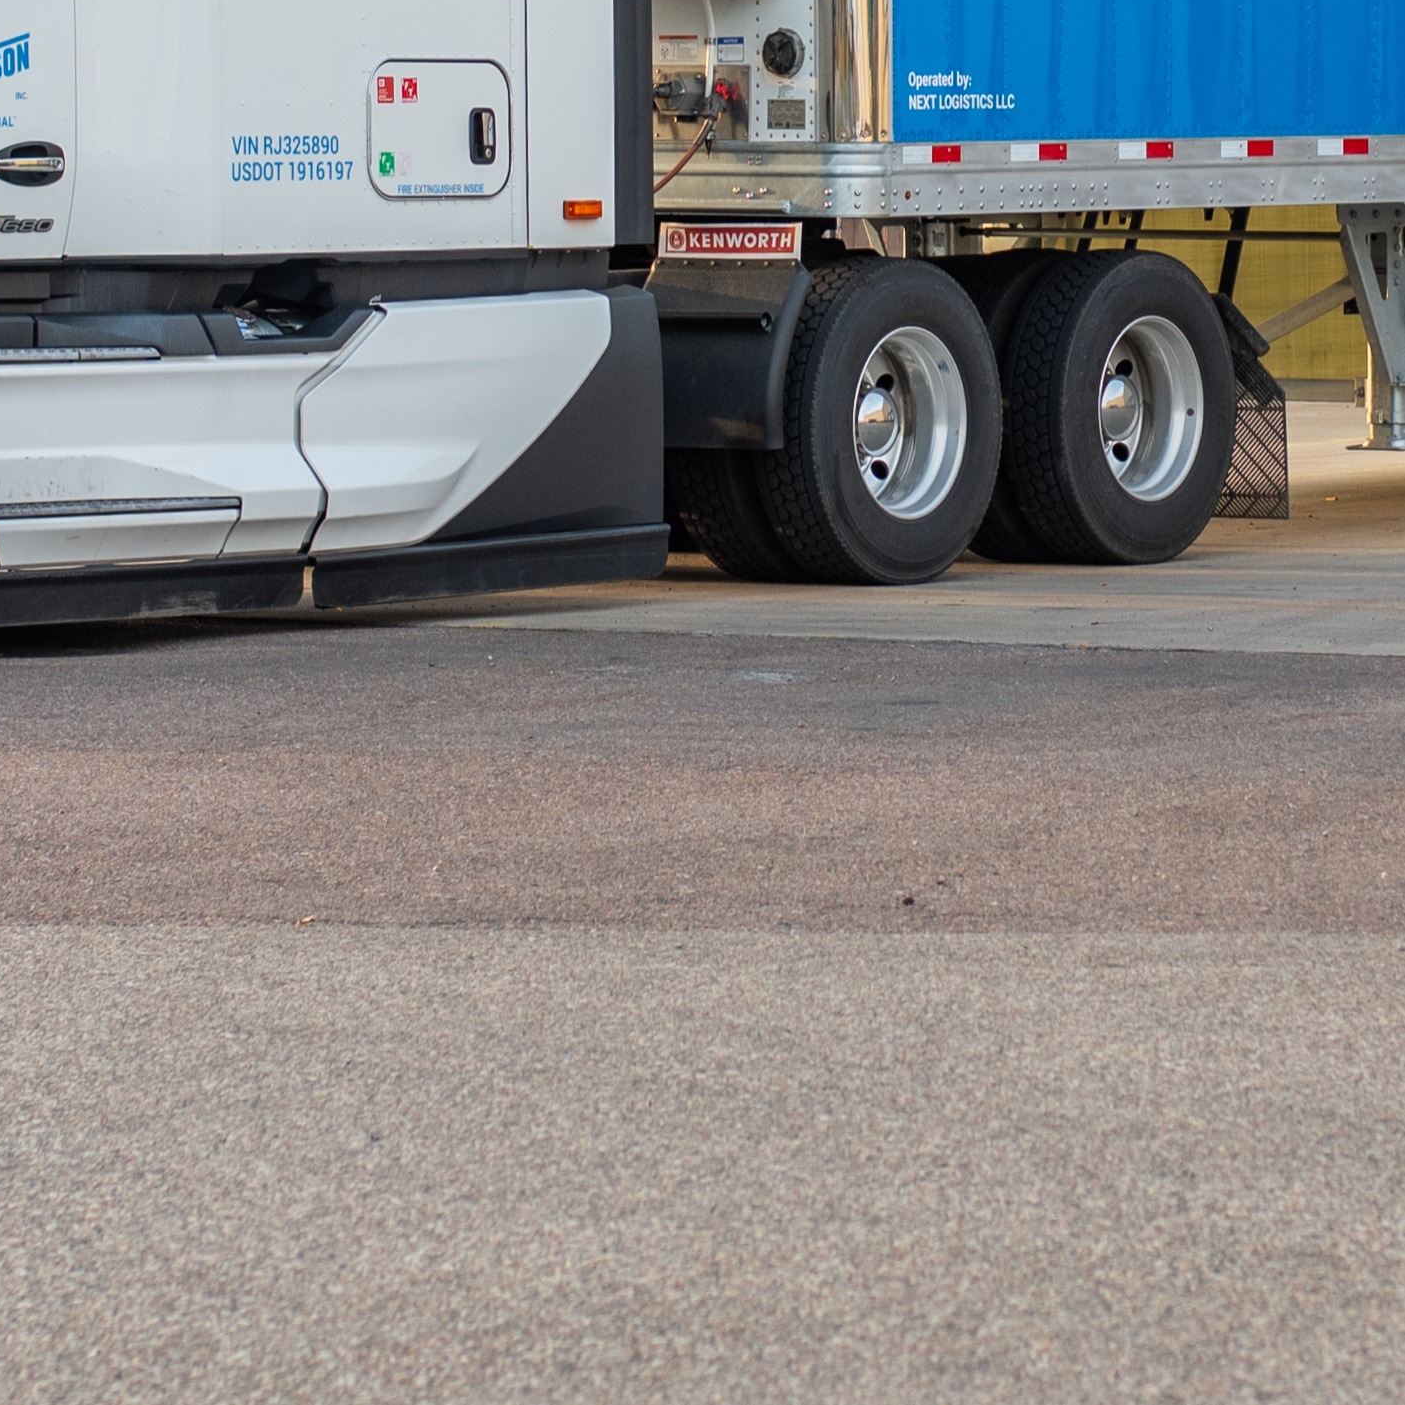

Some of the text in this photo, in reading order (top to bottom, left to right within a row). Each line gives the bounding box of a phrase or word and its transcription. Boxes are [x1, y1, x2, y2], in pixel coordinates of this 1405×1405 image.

[908, 70, 971, 91] Operated by:
[908, 93, 1015, 110] NEXT LOGISTICS LLC
[231, 135, 339, 155] VIN RJ325890
[231, 161, 353, 181] USDOT 1916197
[397, 183, 484, 195] FIRE EXTINGUISHER INSIDE
[689, 232, 792, 248] KENWORTH
